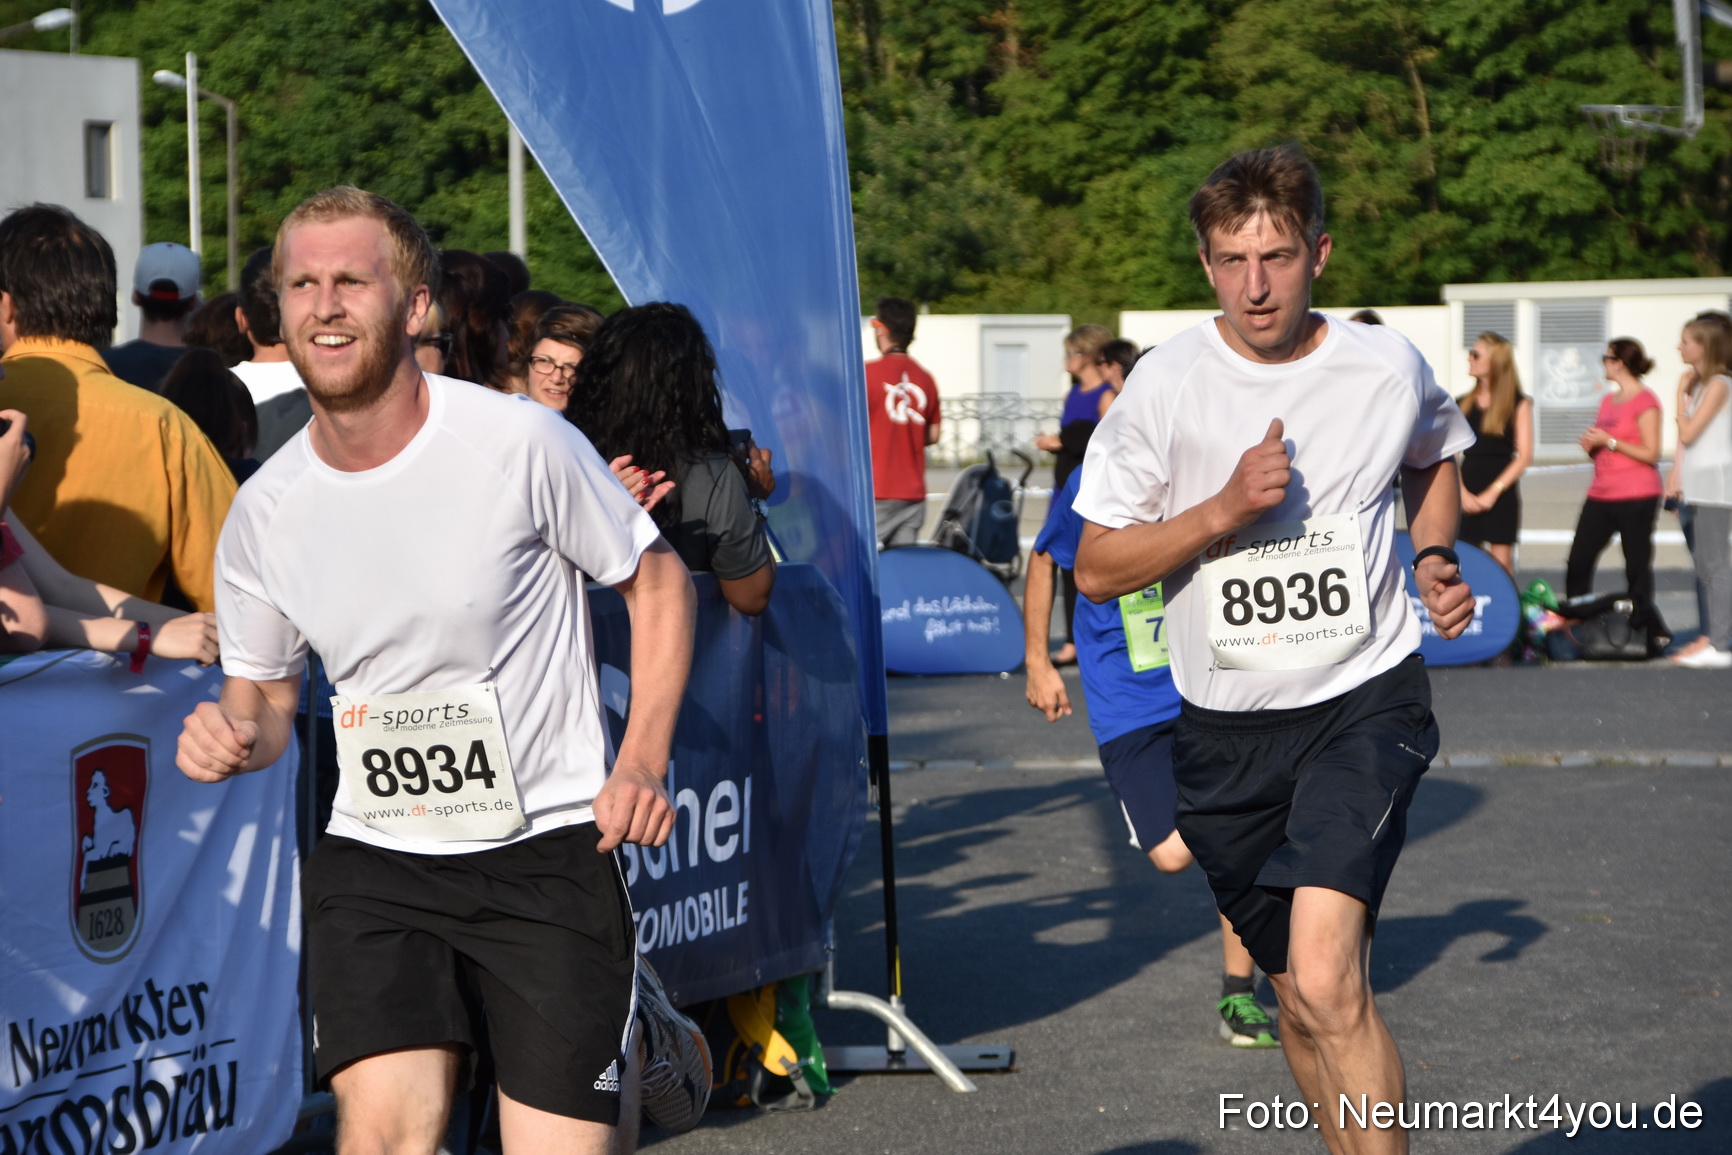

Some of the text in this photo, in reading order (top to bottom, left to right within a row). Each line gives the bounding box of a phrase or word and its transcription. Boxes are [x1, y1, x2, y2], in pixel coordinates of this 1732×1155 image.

[1206, 530, 1334, 559] df-sports
[1247, 543, 1356, 562] die moderne Zeitmessung
[1221, 567, 1351, 627] 8936
[1215, 624, 1365, 647] www.df-sports.de
[340, 702, 469, 729] df-sports
[383, 715, 493, 732] die moderne Zeitmessung
[361, 739, 497, 798] 8934
[363, 798, 514, 820] www.df-sports.de
[88, 907, 123, 941] 1628
[8, 978, 208, 1088] Neumarkter
[593, 1079, 620, 1092] adidas
